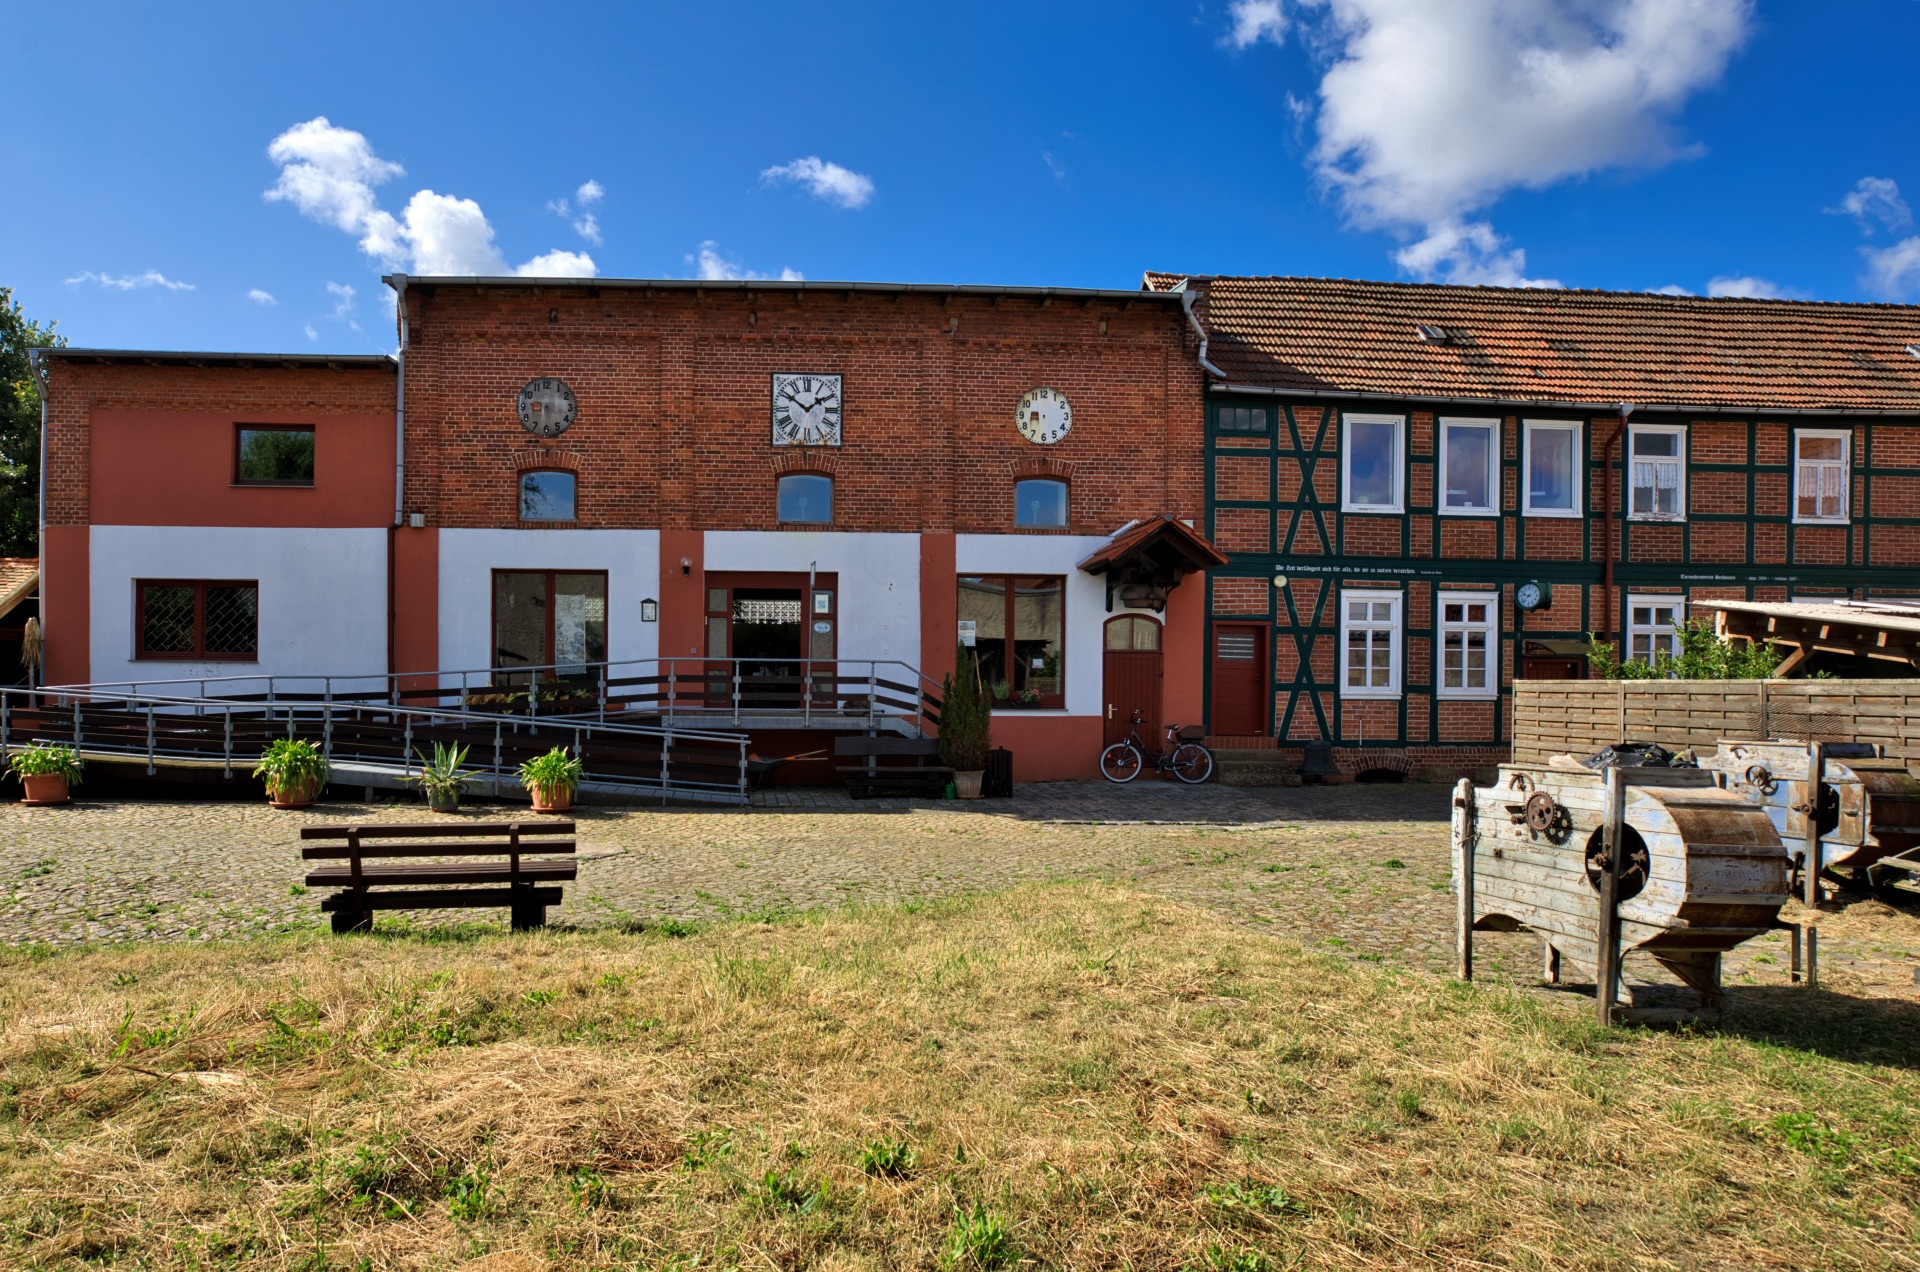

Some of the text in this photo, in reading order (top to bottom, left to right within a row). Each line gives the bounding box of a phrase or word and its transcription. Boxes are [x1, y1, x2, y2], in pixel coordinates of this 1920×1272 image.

[803, 379, 811, 392] XII
[816, 382, 824, 394] I
[525, 391, 532, 399] 10
[564, 392, 569, 400] 2
[823, 393, 835, 402] II
[521, 403, 526, 411] 9
[568, 404, 573, 412] 3
[544, 425, 549, 433] 6
[816, 426, 825, 437] V
[804, 428, 811, 441] VI
[1052, 430, 1057, 439] 5
